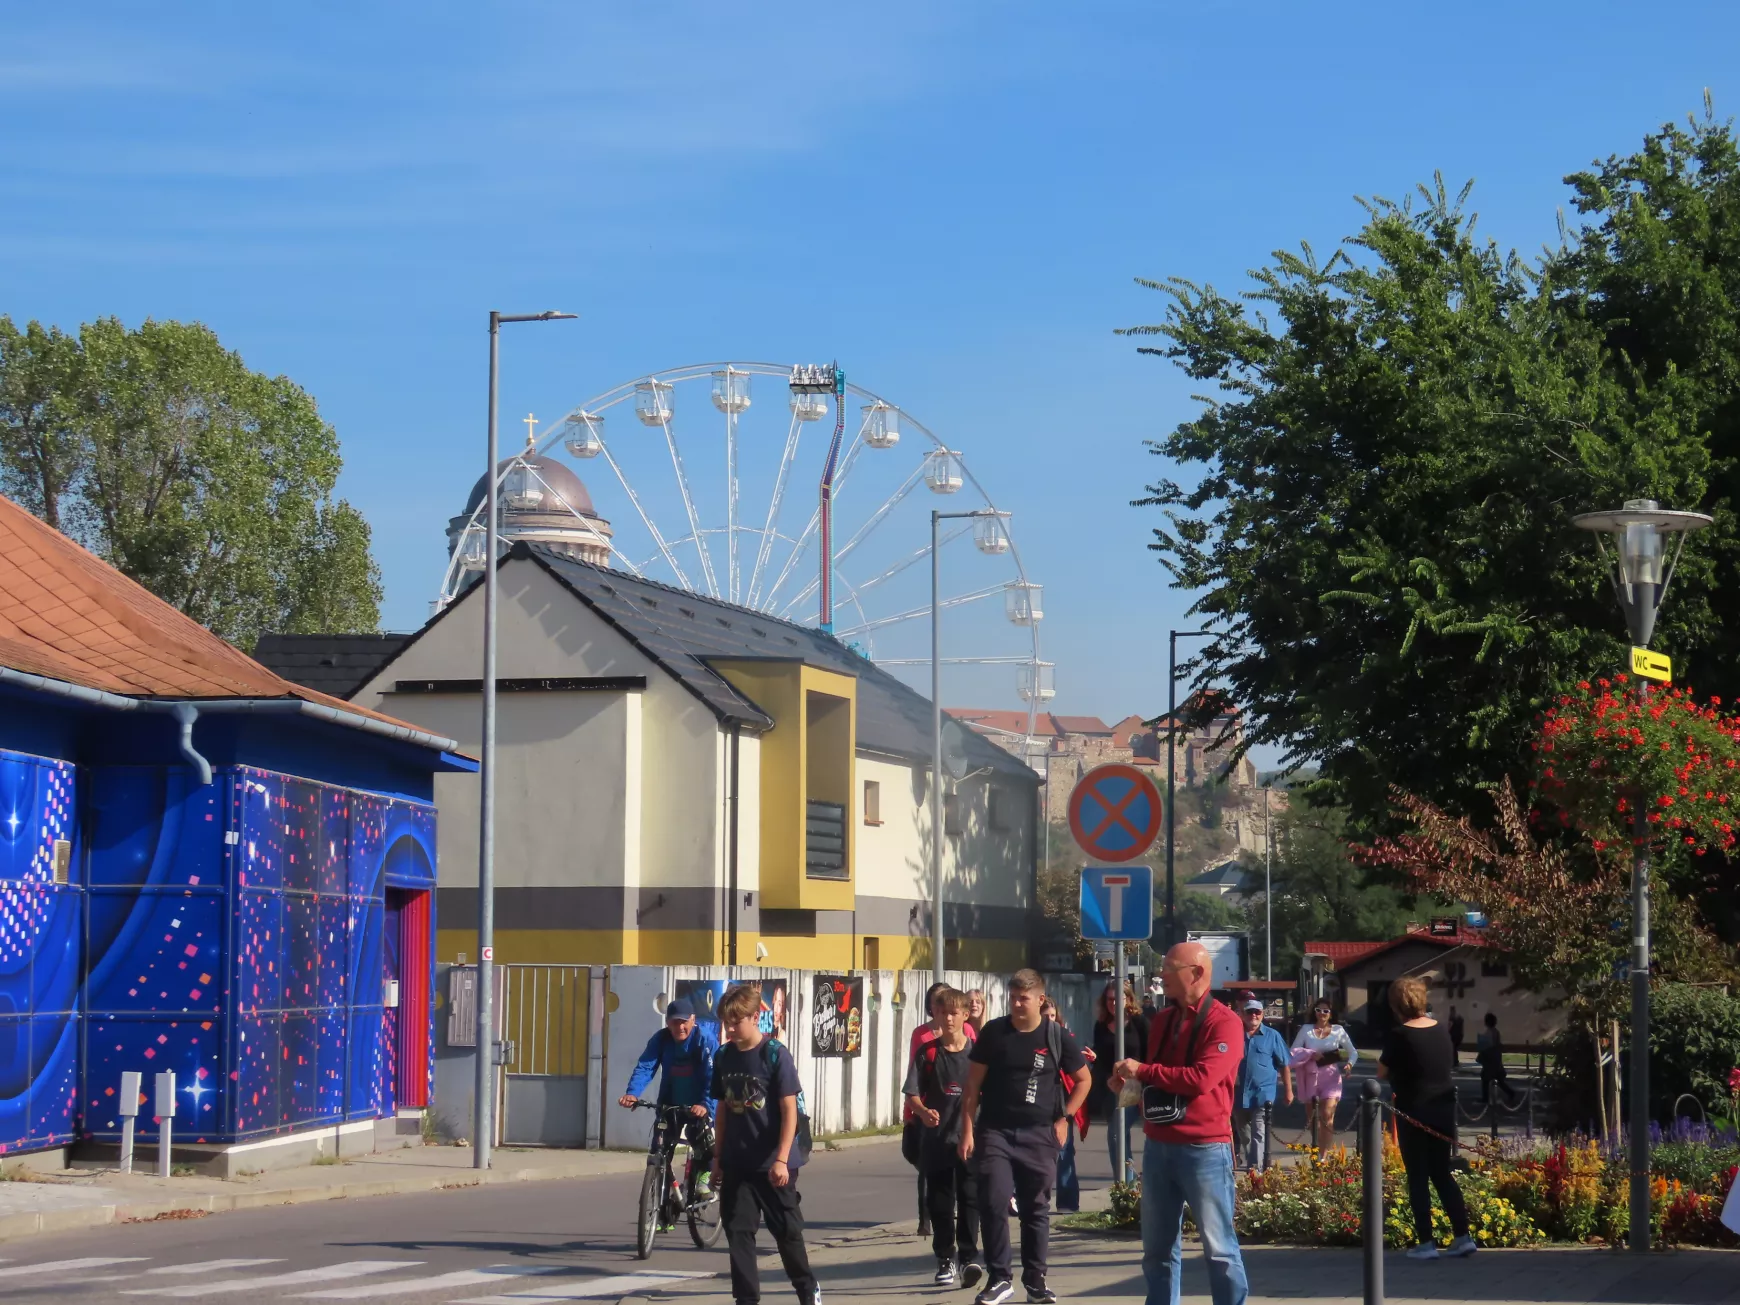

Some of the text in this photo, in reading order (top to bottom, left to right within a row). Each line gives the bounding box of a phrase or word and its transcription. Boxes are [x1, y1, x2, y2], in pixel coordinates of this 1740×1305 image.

[1634, 654, 1648, 670] WC
[484, 948, 492, 959] C
[758, 1010, 773, 1033] GAS
